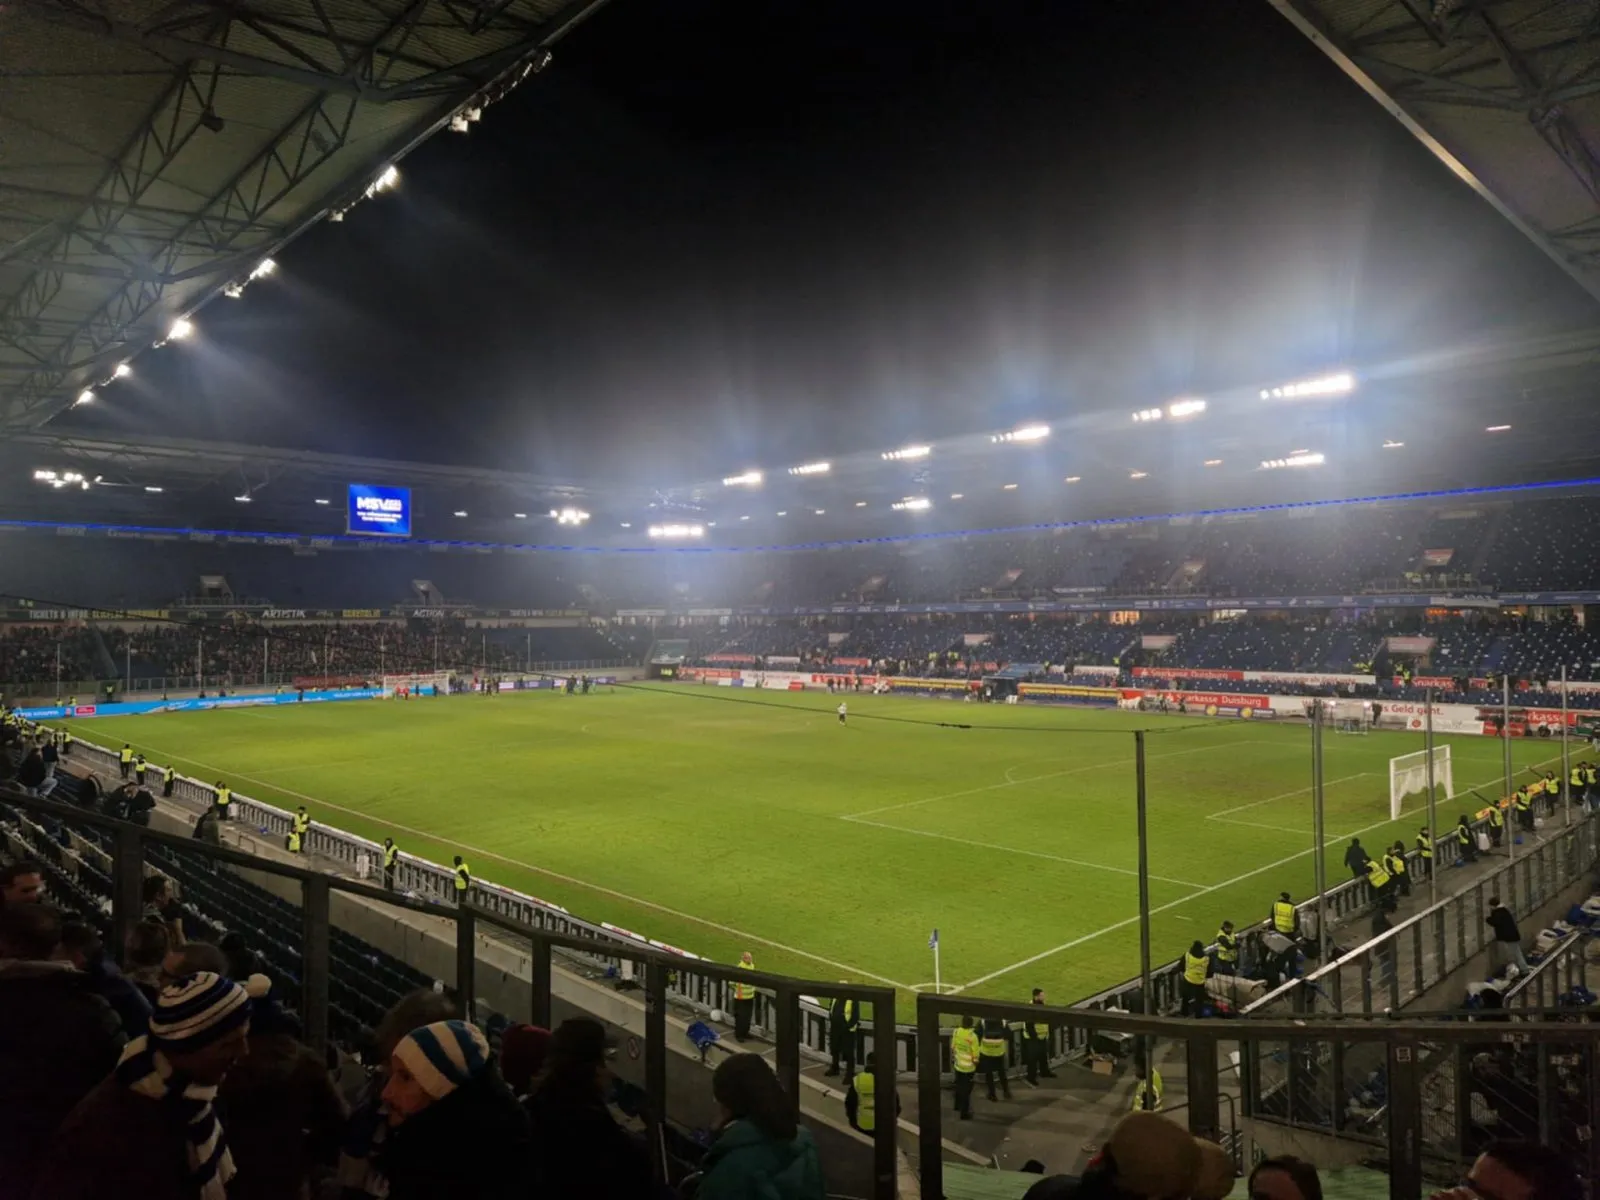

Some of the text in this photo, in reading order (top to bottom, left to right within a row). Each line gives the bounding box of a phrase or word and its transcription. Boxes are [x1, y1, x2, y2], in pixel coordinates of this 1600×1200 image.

[261, 609, 306, 619] ARTISTIK
[412, 608, 445, 618] ACTION
[1177, 693, 1262, 708] Sarkasse Duisburg
[1391, 704, 1415, 714] Geld
